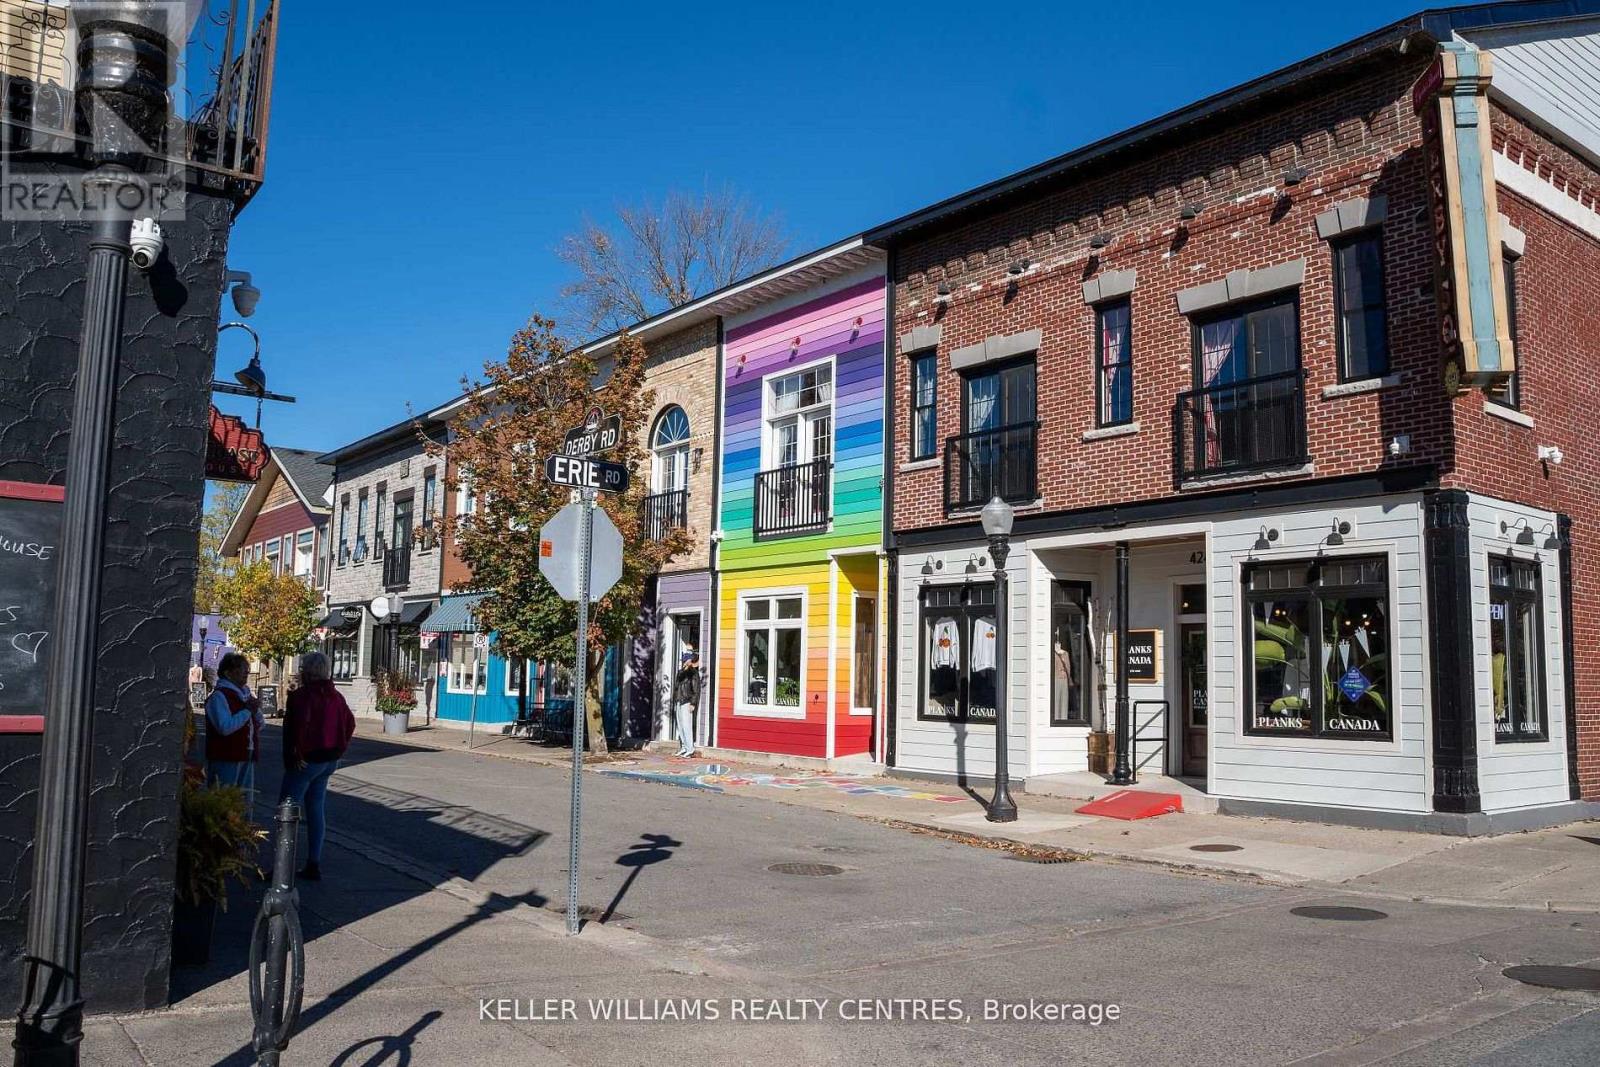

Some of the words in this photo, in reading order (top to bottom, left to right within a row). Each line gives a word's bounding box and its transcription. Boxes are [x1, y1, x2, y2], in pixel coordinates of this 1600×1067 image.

[565, 433, 598, 456] DERBY
[601, 429, 616, 449] RD
[554, 457, 600, 487] ERIE
[605, 470, 621, 484] RD
[1128, 646, 1152, 654] ANKS
[1128, 656, 1152, 665] NADA
[970, 706, 996, 717] CANAD
[1259, 716, 1303, 728] PLANKS
[1329, 718, 1380, 731] CANADA
